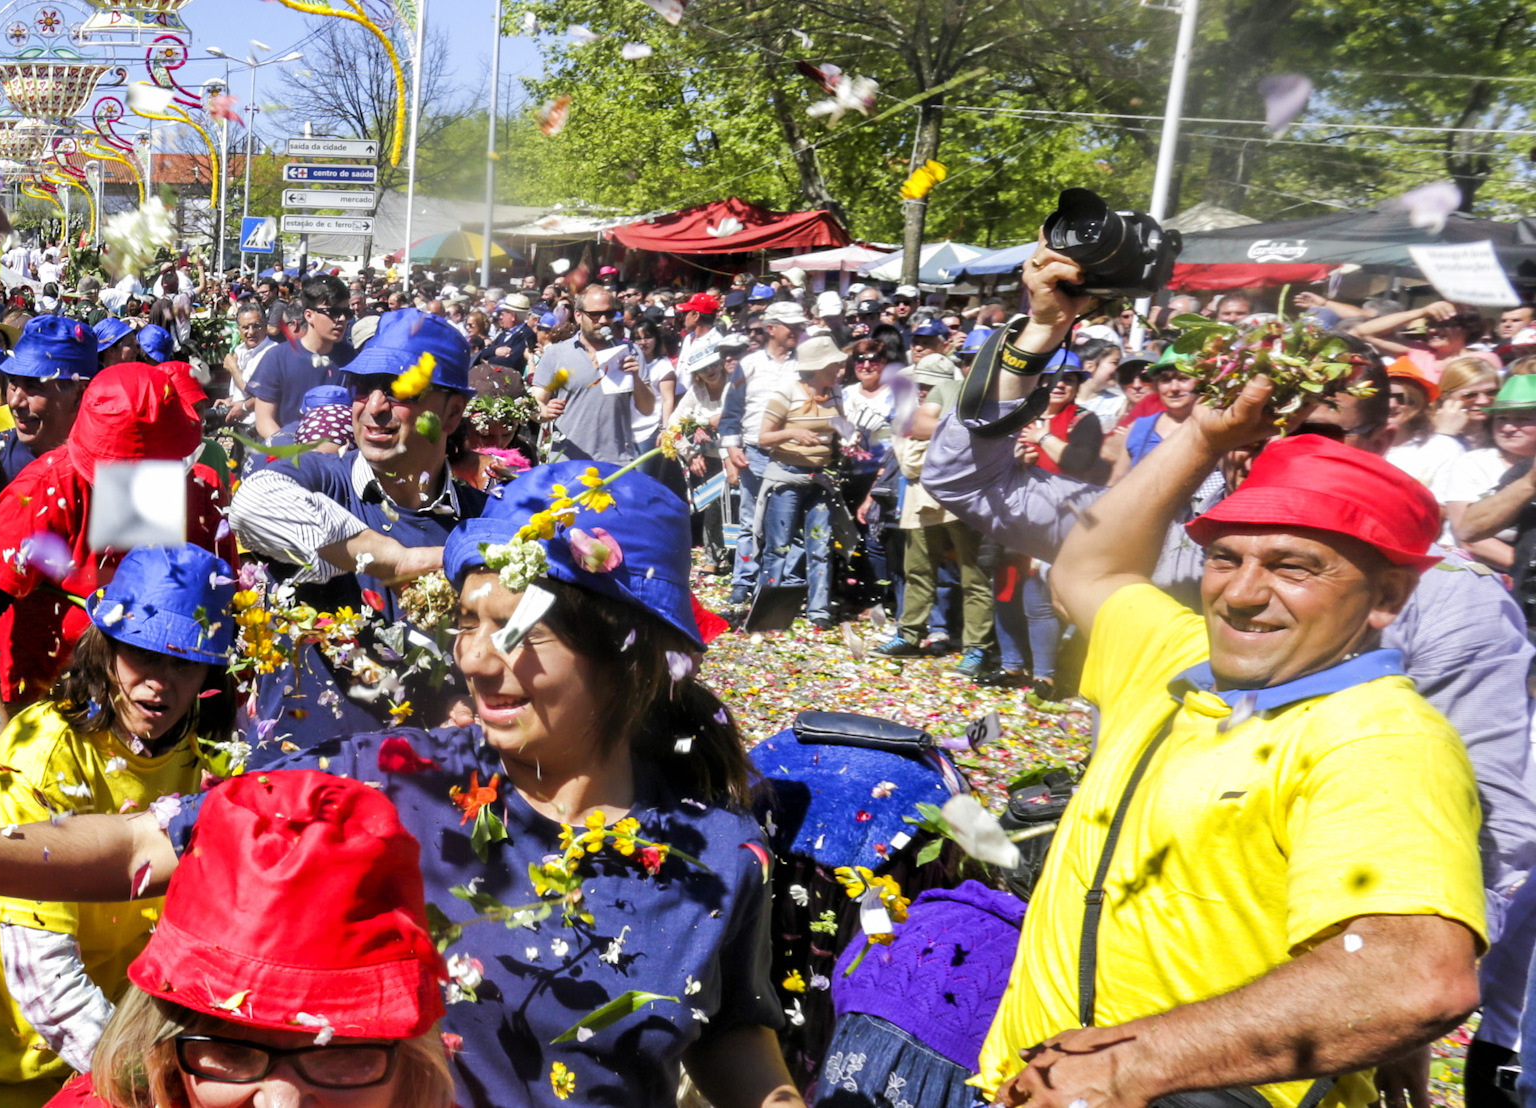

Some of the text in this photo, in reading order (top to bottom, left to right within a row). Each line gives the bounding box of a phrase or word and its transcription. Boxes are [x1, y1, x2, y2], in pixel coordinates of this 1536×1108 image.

[322, 143, 347, 151] cidade
[351, 170, 374, 178] saúde
[286, 220, 314, 229] estação
[315, 220, 325, 228] de
[335, 221, 352, 229] ferro
[1247, 240, 1309, 261] Carlsberg
